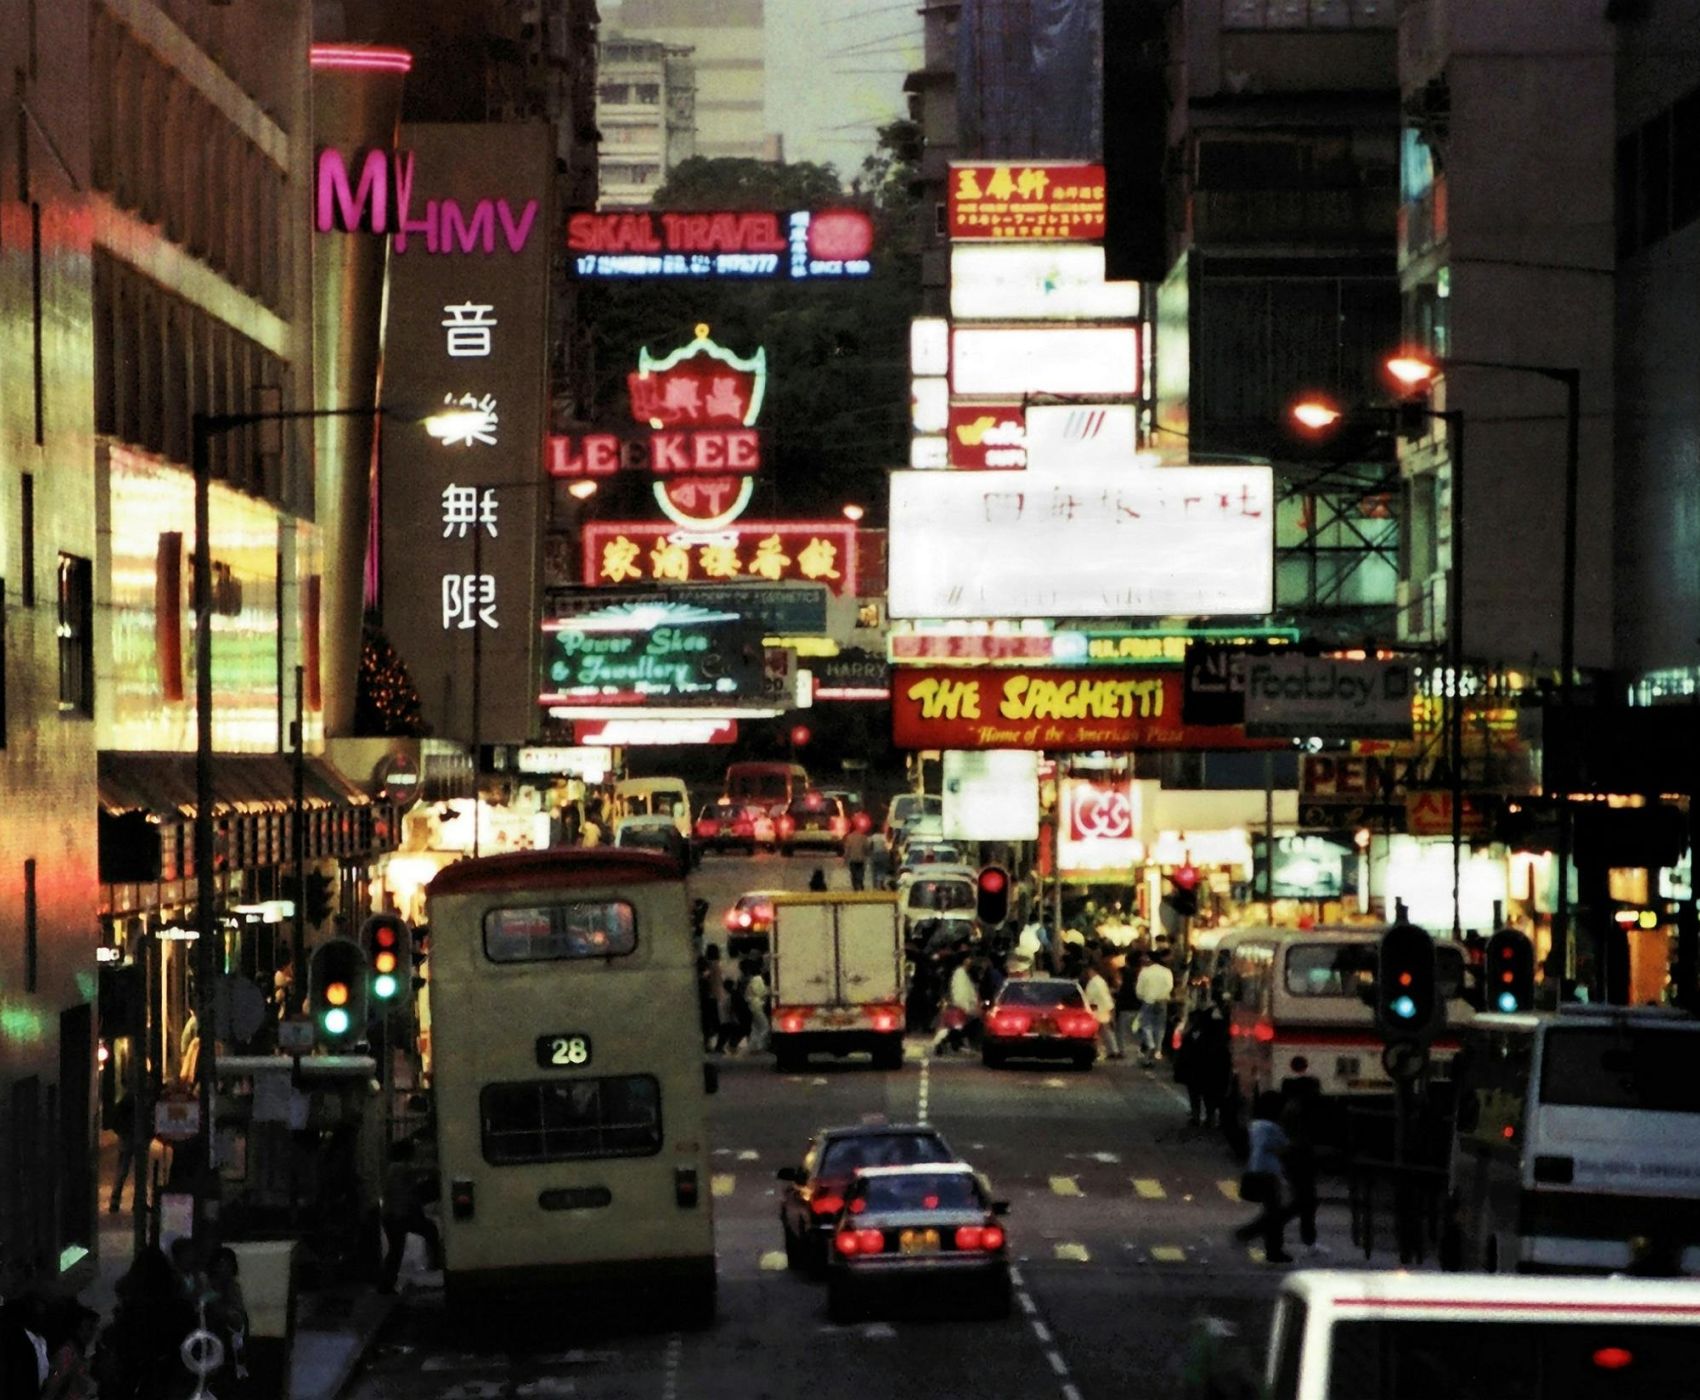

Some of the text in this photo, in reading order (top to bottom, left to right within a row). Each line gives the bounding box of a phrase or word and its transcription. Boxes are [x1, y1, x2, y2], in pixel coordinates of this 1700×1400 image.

[395, 200, 538, 253] HMV
[662, 212, 786, 249] TRAVEL
[652, 431, 759, 470] KEE
[908, 678, 981, 719] THE
[1020, 725, 1042, 745] of
[1045, 726, 1064, 743] the
[552, 1038, 587, 1064] 28
